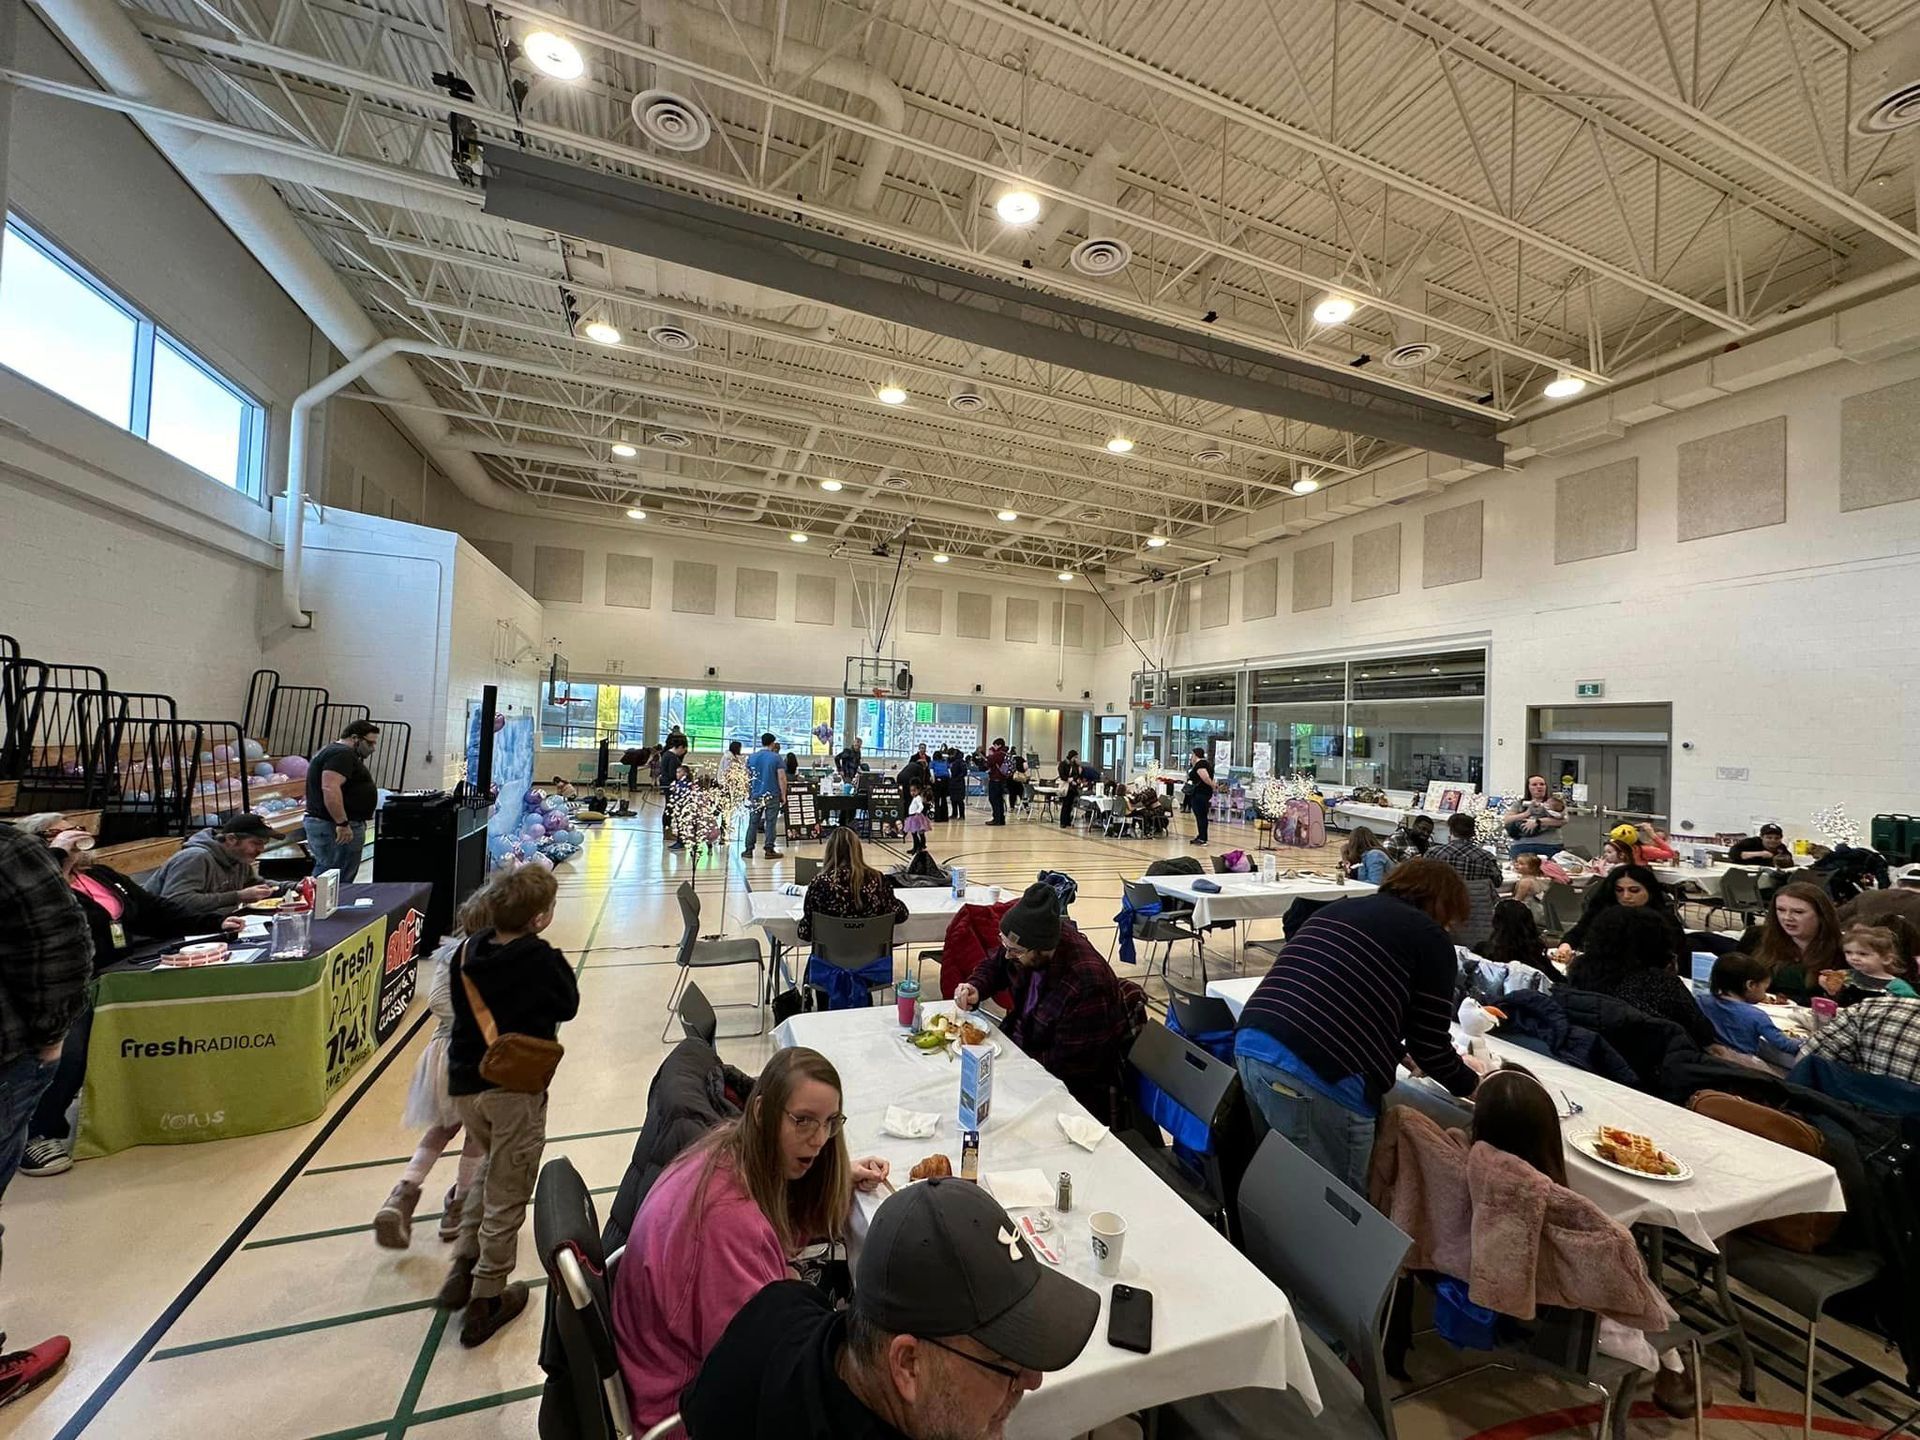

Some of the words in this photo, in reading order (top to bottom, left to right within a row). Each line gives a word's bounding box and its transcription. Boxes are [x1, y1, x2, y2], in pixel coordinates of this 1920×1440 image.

[332, 935, 374, 992] Fresh
[385, 908, 415, 975] BIG
[329, 969, 371, 1032] RADIO
